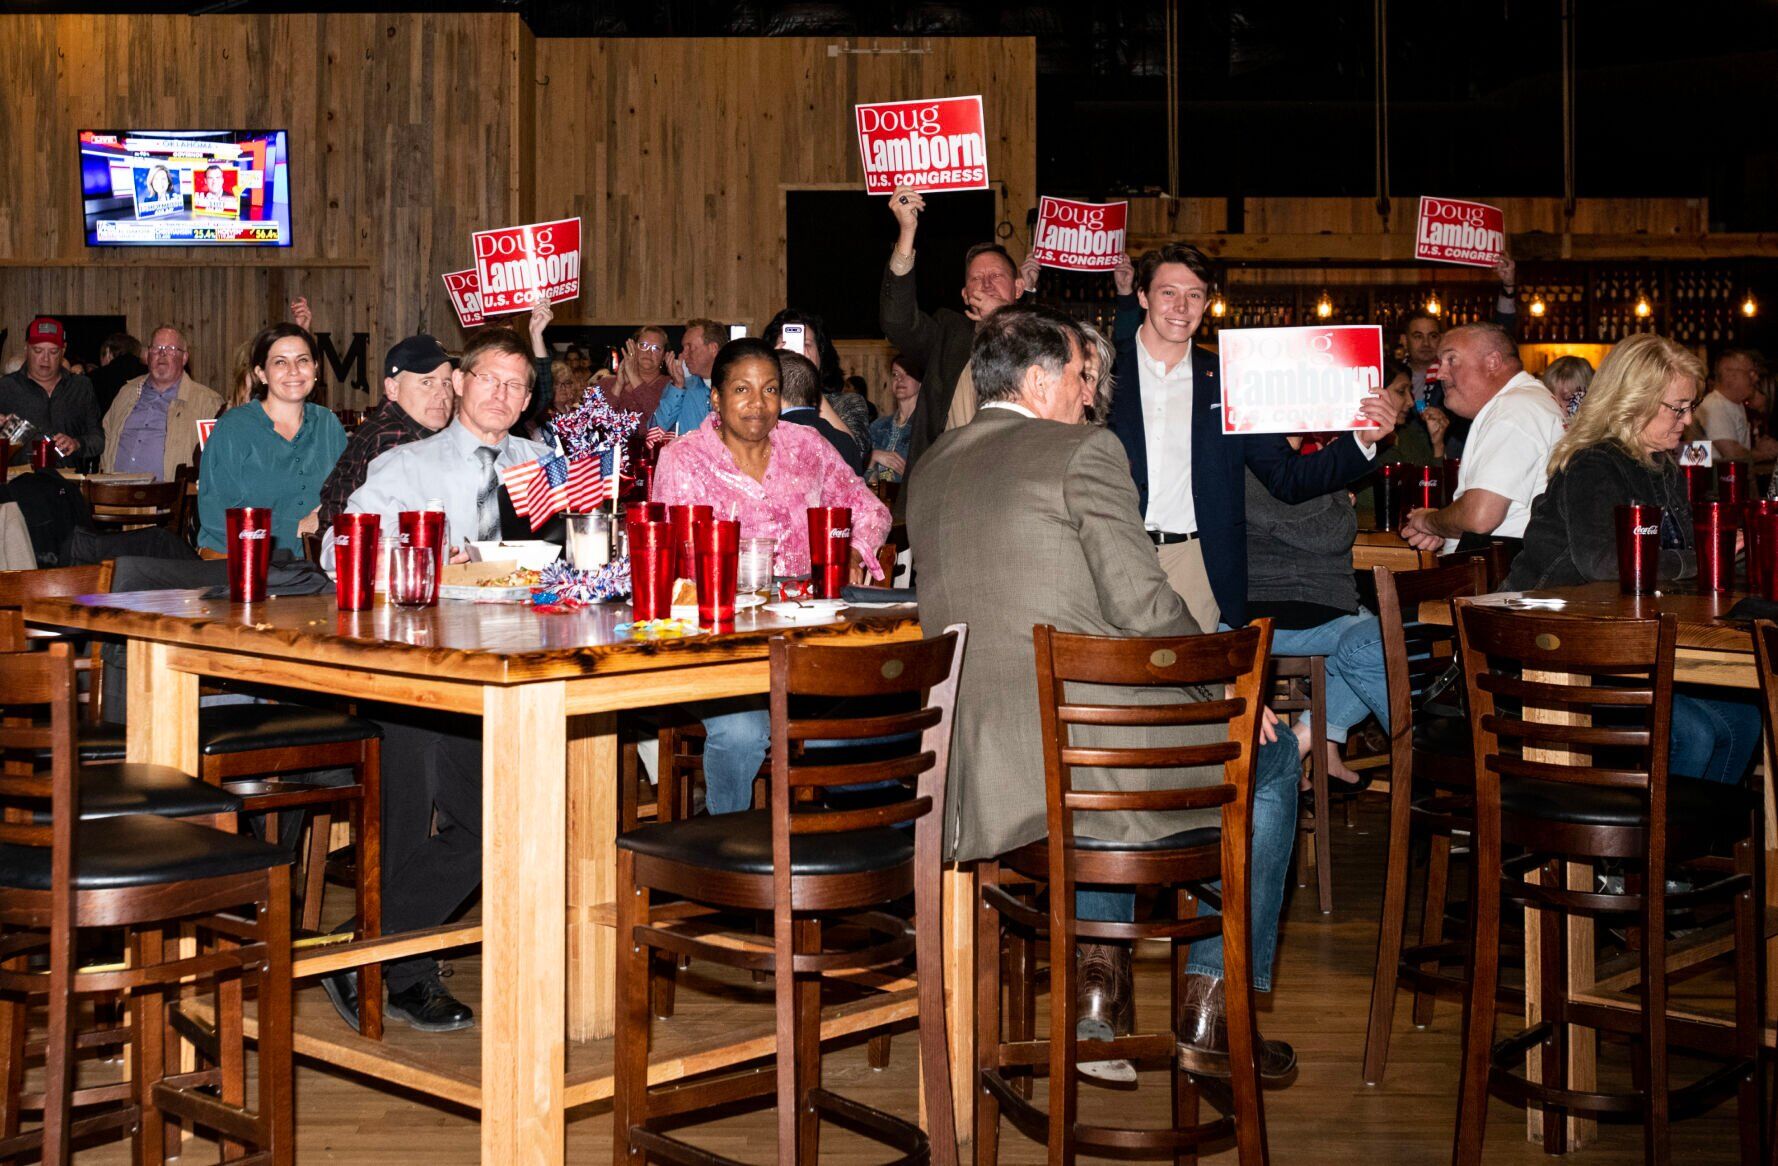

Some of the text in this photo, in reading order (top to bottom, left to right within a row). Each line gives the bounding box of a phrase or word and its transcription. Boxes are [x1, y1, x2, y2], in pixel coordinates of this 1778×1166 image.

[860, 104, 941, 135] Doug
[862, 131, 984, 173] Lamborn
[868, 168, 984, 187] U.S. CONGRESS
[1042, 199, 1105, 230] Doug
[1423, 199, 1485, 227] Doug
[477, 227, 555, 258] Doug
[1037, 218, 1124, 255] Lamborn
[1420, 216, 1504, 252] Lamborn
[1059, 253, 1123, 266] CONGRESS
[1419, 245, 1441, 255] U.S.
[478, 250, 578, 294] Lamborn
[484, 294, 510, 308] U.S.
